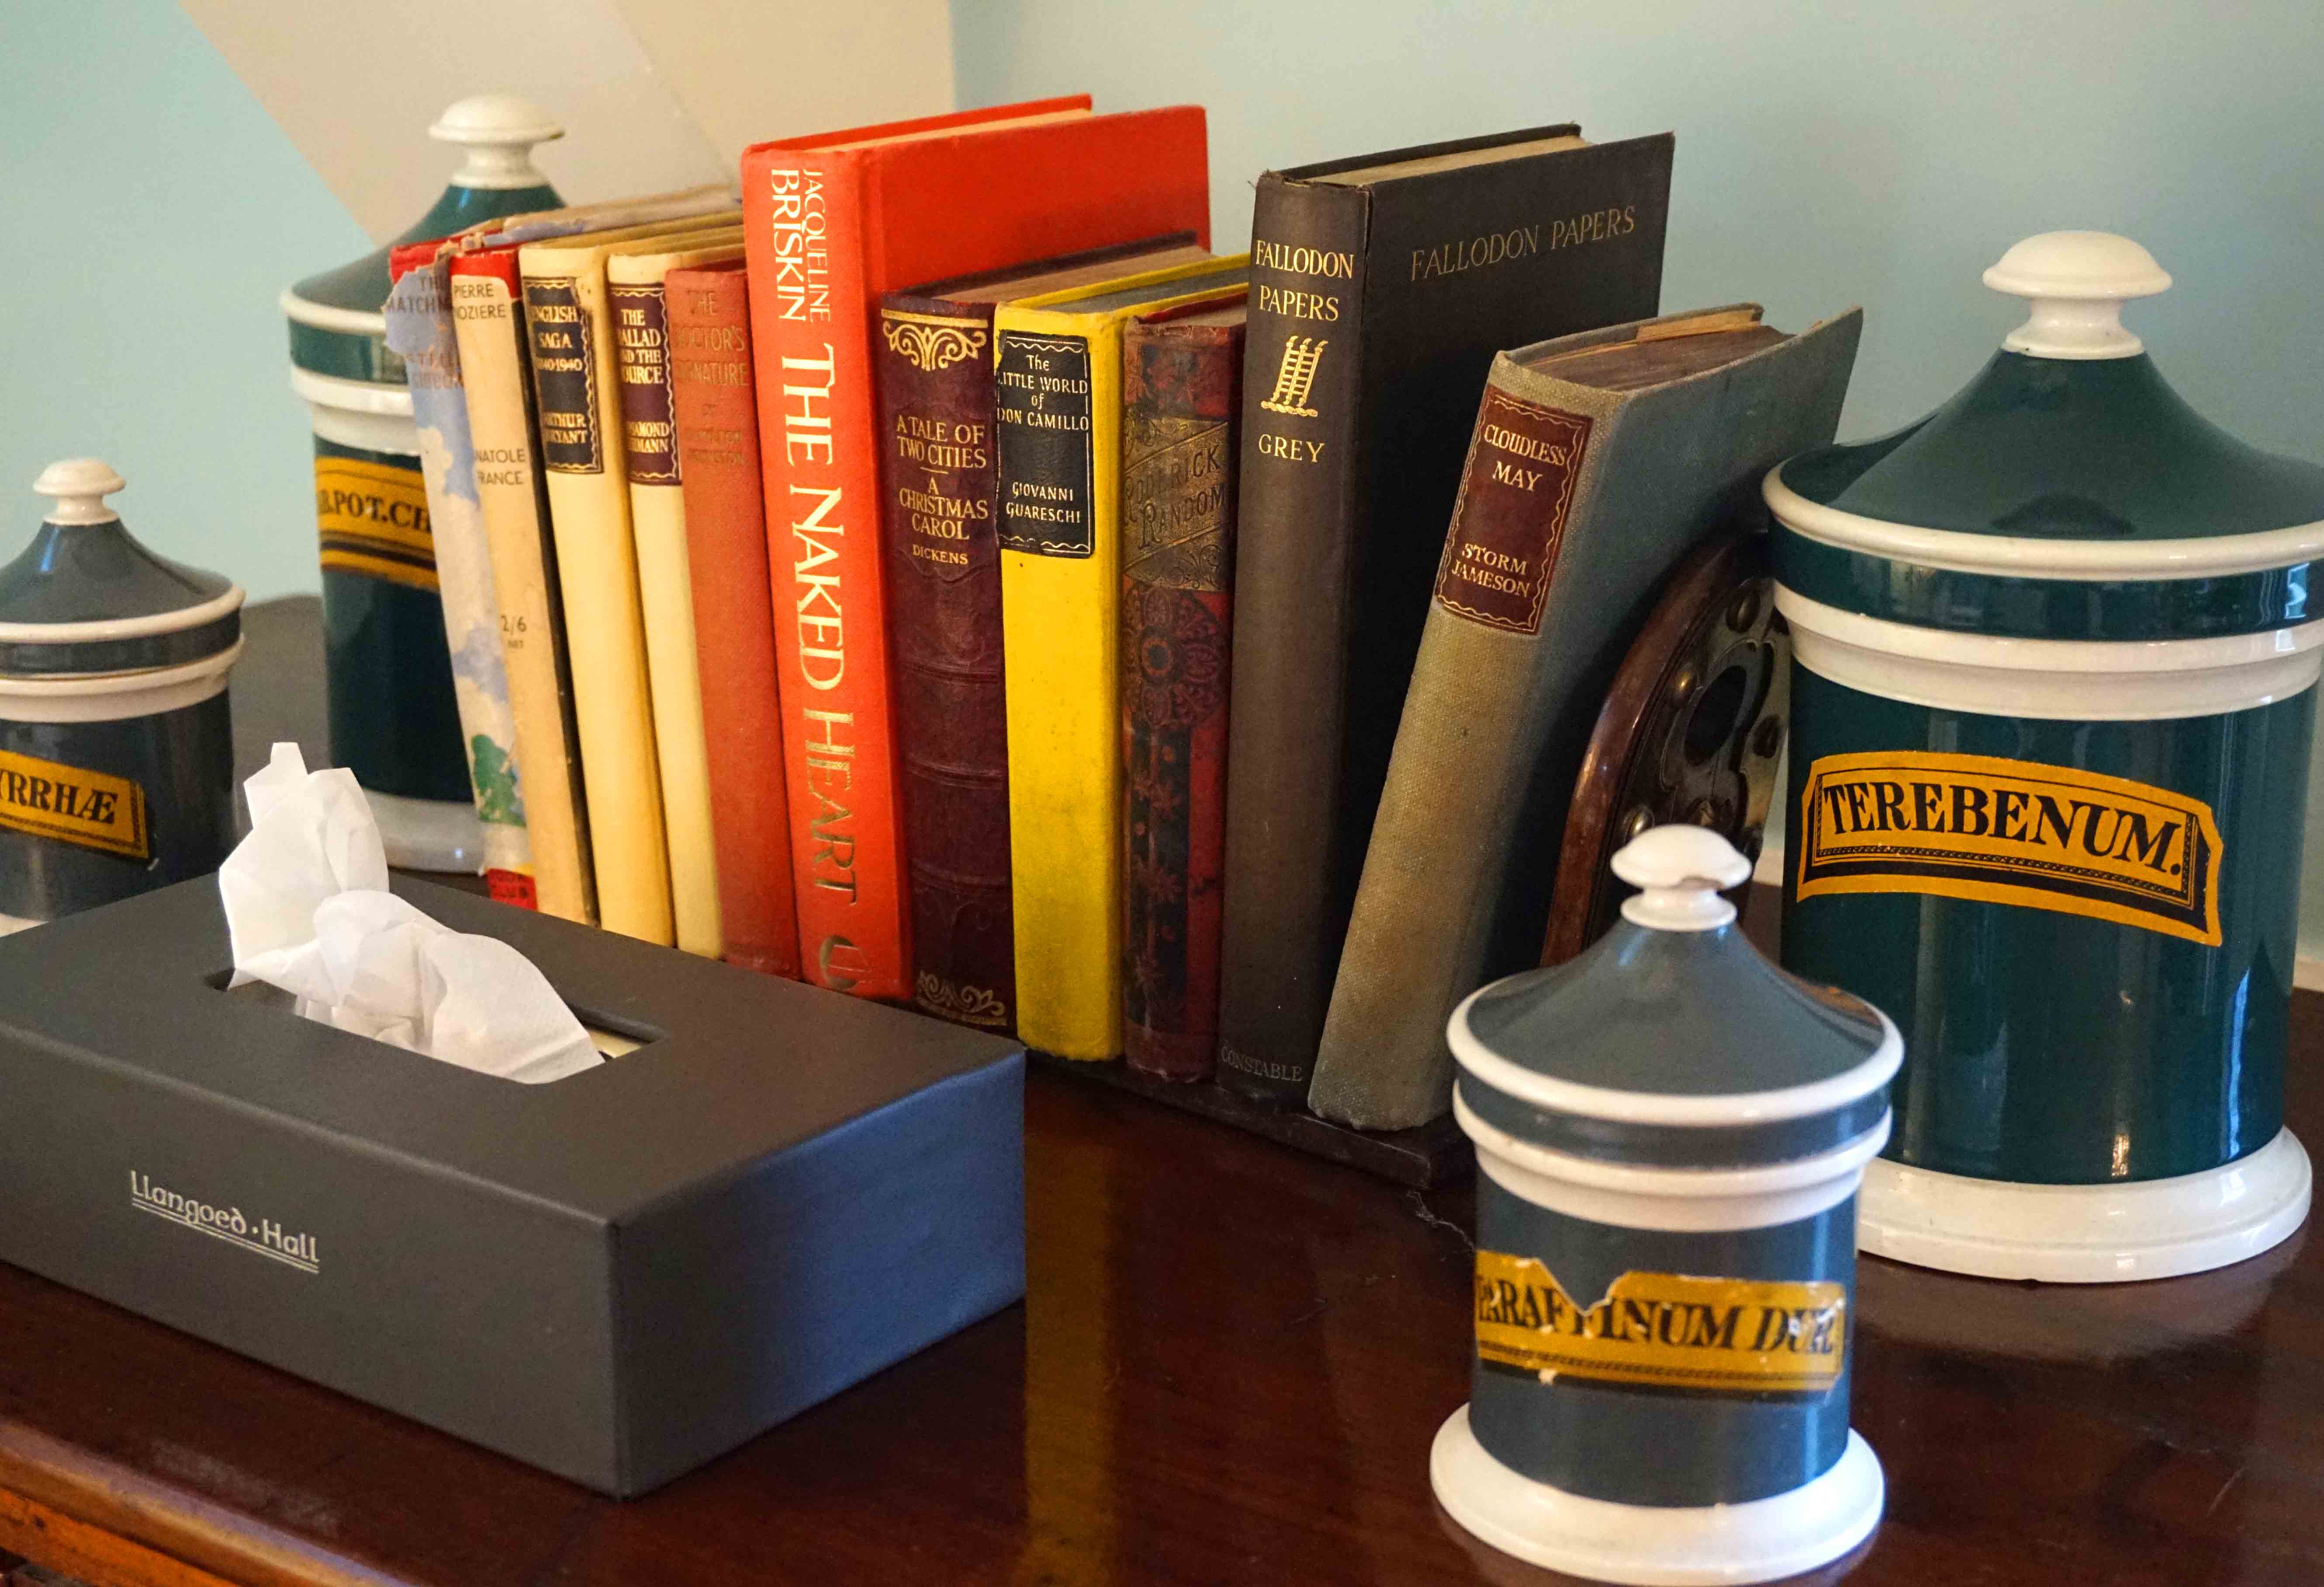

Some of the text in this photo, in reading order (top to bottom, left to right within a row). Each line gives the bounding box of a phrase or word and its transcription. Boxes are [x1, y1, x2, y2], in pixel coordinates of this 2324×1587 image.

[771, 169, 806, 321] BRISKIN
[802, 169, 831, 322] JACQUELINE
[1411, 205, 1636, 281] FALLODON PAPERS
[1255, 239, 1354, 280] FALLODON
[620, 308, 646, 326] THE
[1259, 285, 1339, 322] PAPERS
[636, 349, 662, 364] THE
[1026, 354, 1050, 371] The
[1040, 376, 1088, 394] WORLD
[1031, 393, 1044, 409] of
[897, 414, 986, 444] A TALE OF
[1027, 412, 1089, 431] CAMILLO
[897, 436, 987, 469] TWO CITIES
[1259, 433, 1325, 463] GREY
[1484, 424, 1567, 466] CLOUDLESS
[928, 477, 939, 496] A
[1012, 482, 1073, 502] GIOVANNI
[1492, 461, 1544, 492] MAY
[899, 488, 988, 520] CHRISTMAS
[1006, 502, 1080, 523] GUARESCHI
[912, 513, 969, 540] CAROL
[913, 544, 968, 565] DICKENS
[1462, 543, 1527, 575] STORM
[1452, 559, 1530, 599] JAMESON
[782, 343, 857, 906] THE NAKED HEART
[1823, 781, 2182, 876] TEREBENUM.
[1221, 1046, 1302, 1081] CONSTABLE
[131, 1170, 320, 1263] Llangoed Hall
